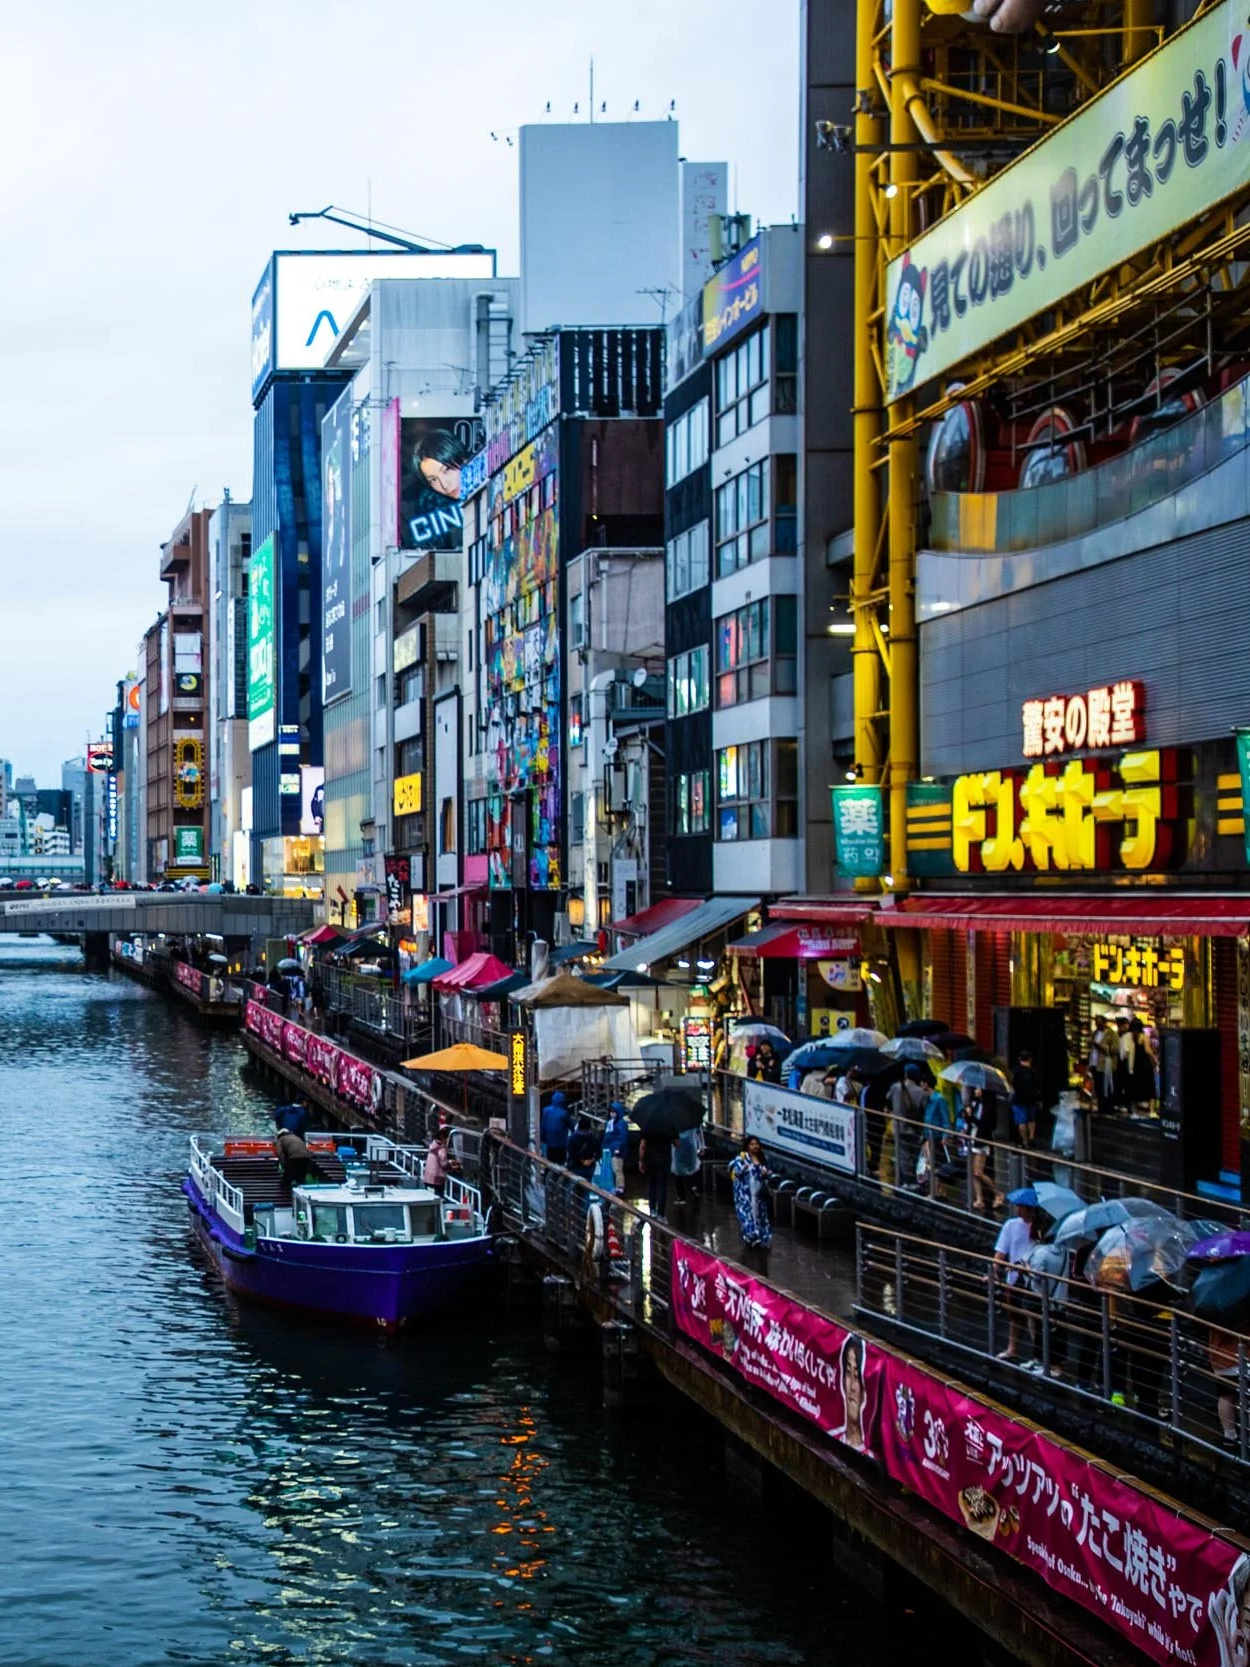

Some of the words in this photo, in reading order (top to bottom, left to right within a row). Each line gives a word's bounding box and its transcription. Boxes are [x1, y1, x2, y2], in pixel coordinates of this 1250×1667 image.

[410, 505, 464, 541] CIN
[1022, 680, 1136, 758] 驚安の殿堂
[839, 799, 878, 835] 薬
